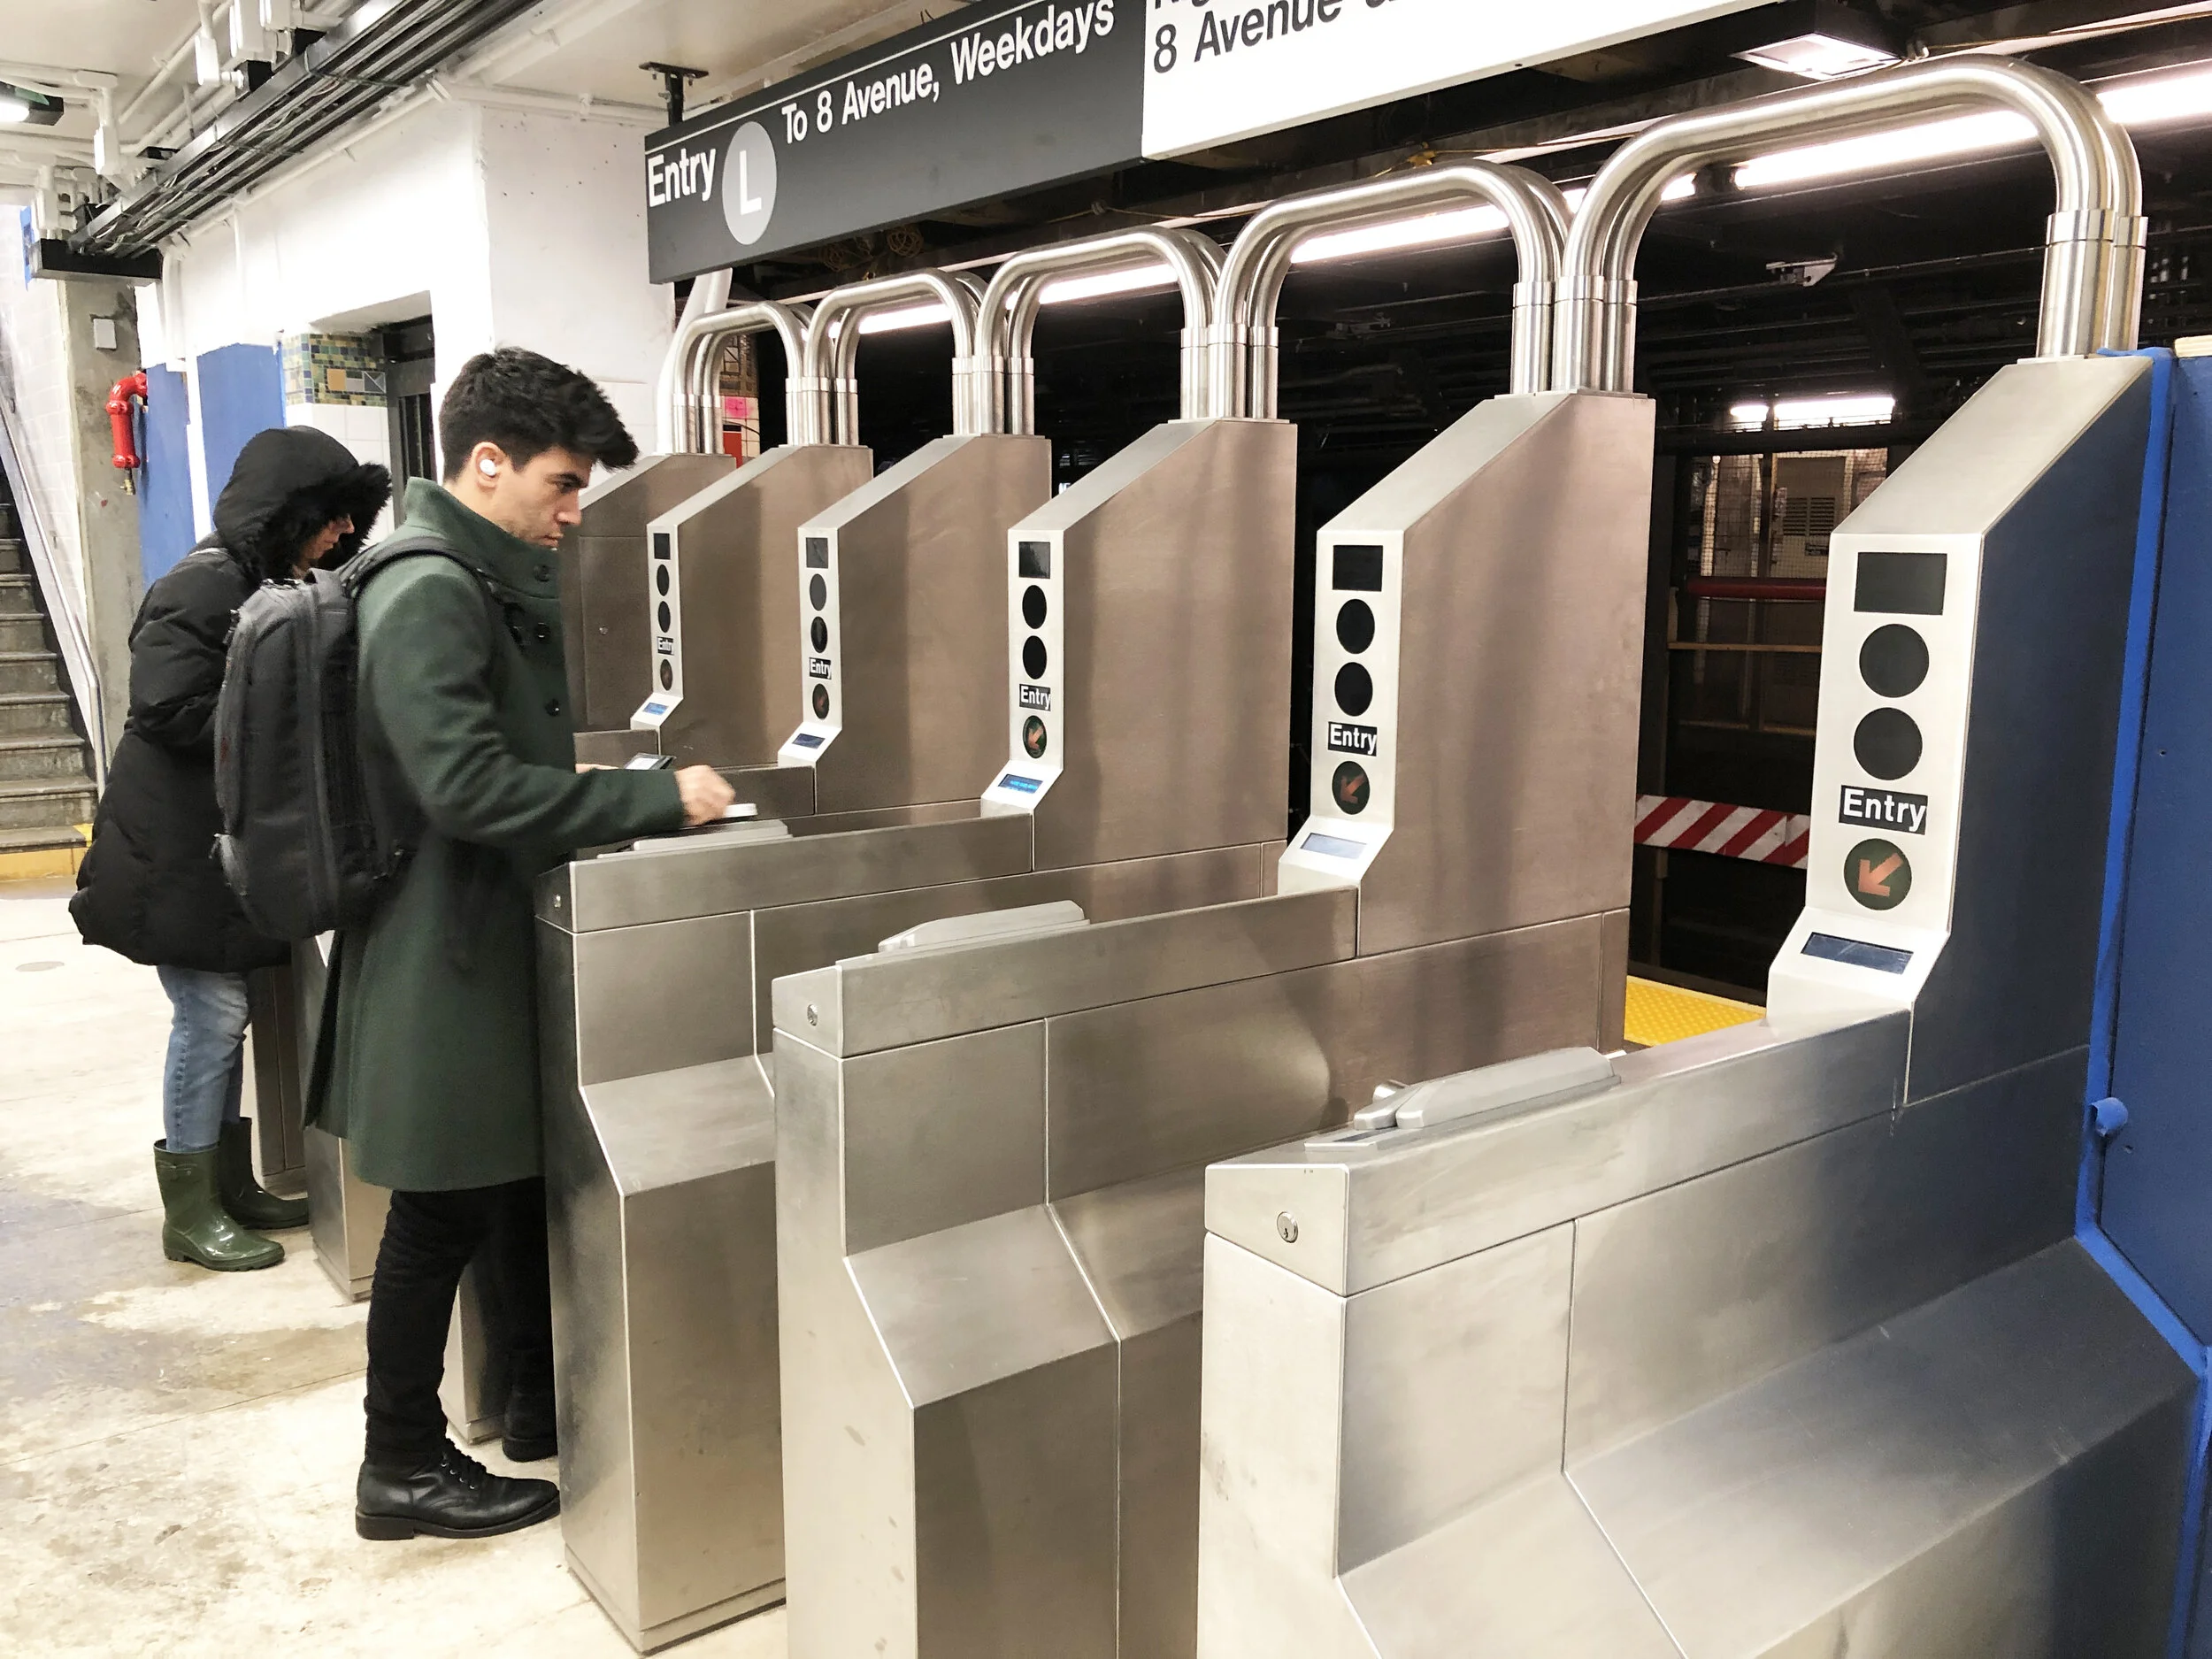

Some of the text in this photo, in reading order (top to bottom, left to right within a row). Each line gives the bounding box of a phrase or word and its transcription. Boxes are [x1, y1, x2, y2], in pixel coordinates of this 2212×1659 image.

[1153, 0, 1343, 73] 8 Avenue
[780, 0, 1115, 145] To 8 Avenue, Weekdays
[648, 148, 763, 216] Entry L
[810, 657, 831, 679] Entry
[1020, 685, 1051, 710] Entry
[1330, 723, 1378, 756] Entry
[1842, 787, 1927, 833] Entry
